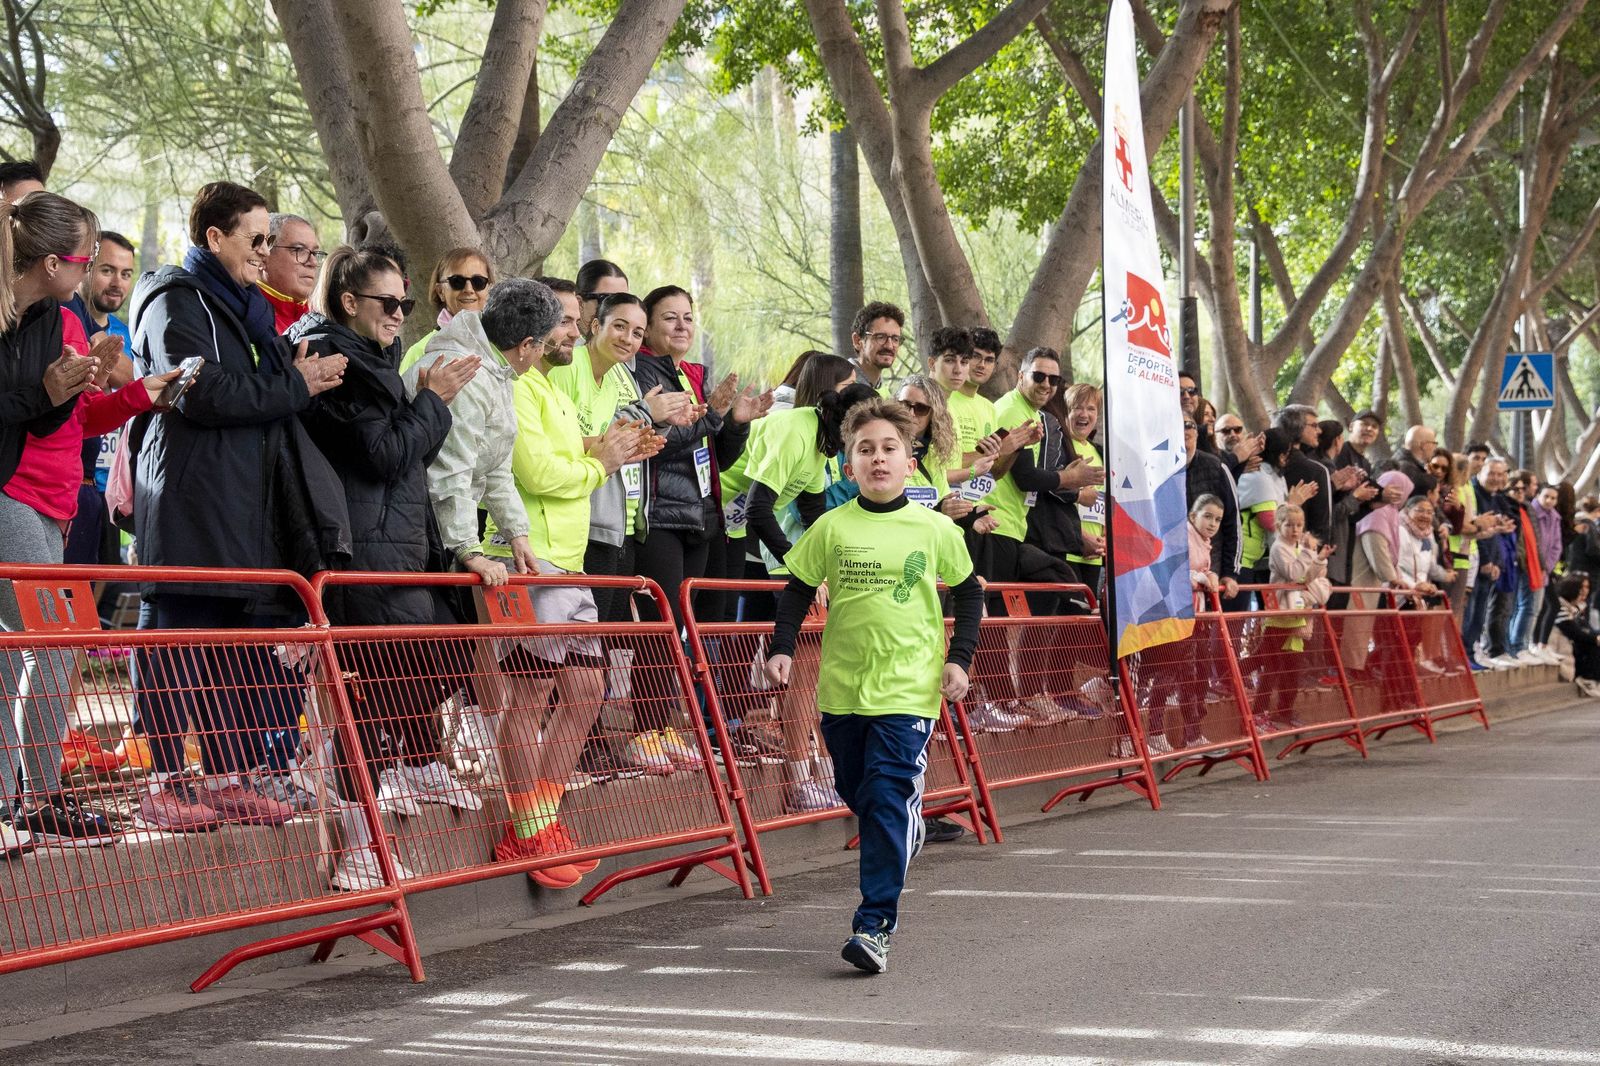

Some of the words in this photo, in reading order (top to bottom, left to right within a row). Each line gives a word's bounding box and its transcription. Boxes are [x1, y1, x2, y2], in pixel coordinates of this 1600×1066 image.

[970, 477, 992, 493] 859
[844, 559, 882, 569] Almería
[869, 577, 897, 586] cáncer
